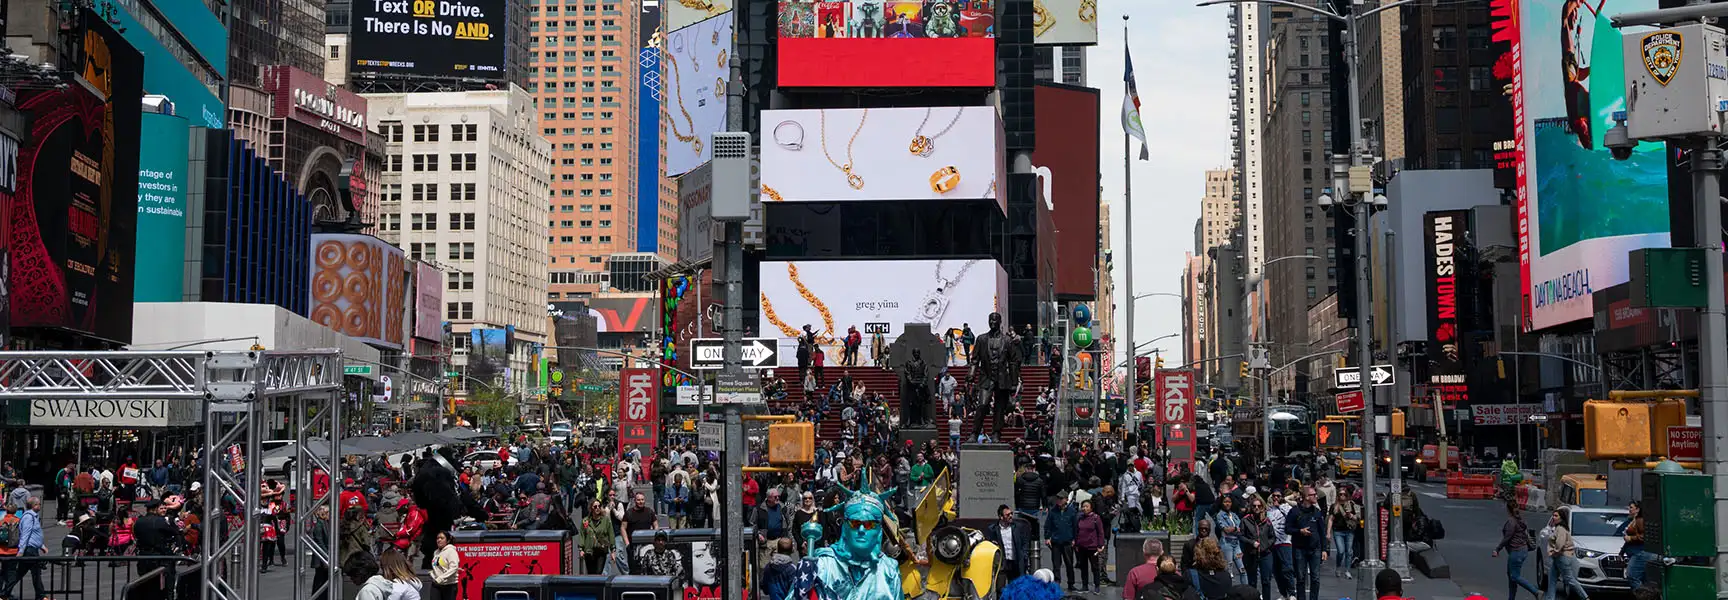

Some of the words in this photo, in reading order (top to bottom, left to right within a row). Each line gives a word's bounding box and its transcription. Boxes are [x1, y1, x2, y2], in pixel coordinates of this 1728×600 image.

[373, 0, 409, 14] Text
[413, 0, 435, 15] OR
[439, 1, 484, 18] Drive.
[364, 17, 410, 34] There
[414, 20, 428, 35] Is
[431, 21, 452, 36] No
[454, 22, 494, 38] AND.
[1651, 34, 1673, 42] POLICE
[1644, 39, 1681, 51] DEPARTMENT
[1493, 141, 1503, 151] ON
[1512, 42, 1525, 178] HERSHEY'S
[1519, 184, 1529, 267] STORE
[165, 171, 173, 179] of
[172, 184, 178, 192] in
[145, 193, 163, 204] they
[146, 206, 183, 217] sustainable
[1434, 215, 1457, 320] HADESTOWN
[855, 302, 875, 311] greg
[877, 299, 899, 311] yüna
[1075, 310, 1083, 318] m
[865, 323, 889, 333] KITH
[1078, 333, 1087, 341] m
[703, 347, 724, 359] ON
[629, 373, 653, 420] tkts
[1164, 374, 1189, 422] tkts
[33, 399, 165, 418] SWAROVSKI
[1476, 405, 1500, 415] Sale
[1670, 431, 1680, 439] NO
[1671, 440, 1700, 450] Anytime
